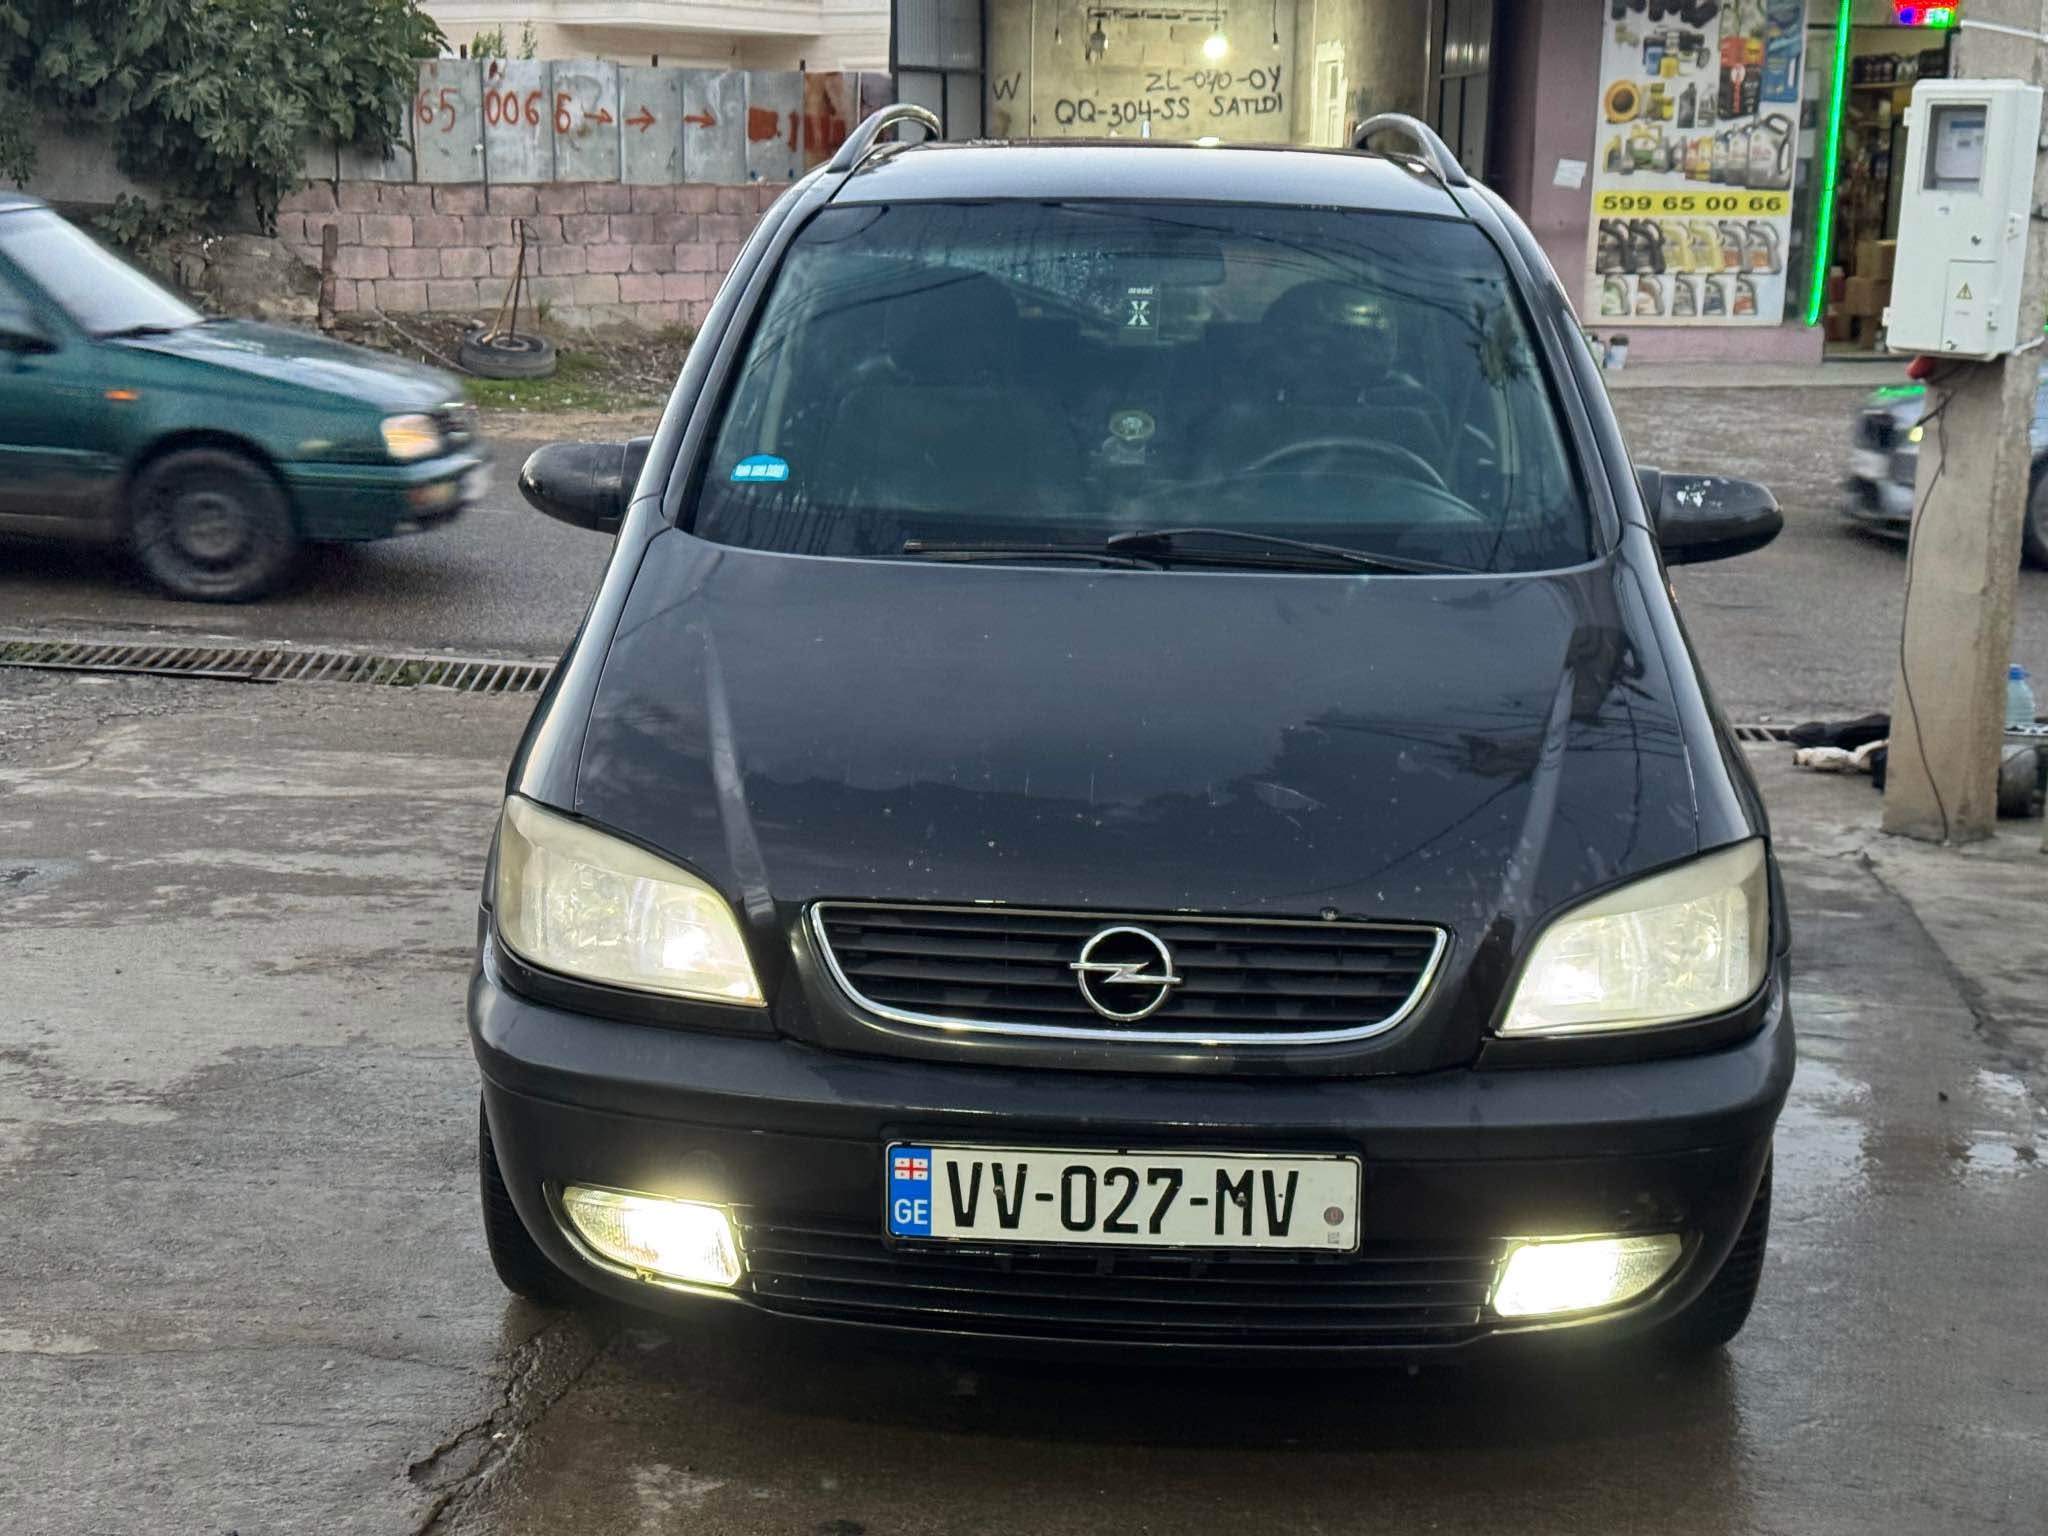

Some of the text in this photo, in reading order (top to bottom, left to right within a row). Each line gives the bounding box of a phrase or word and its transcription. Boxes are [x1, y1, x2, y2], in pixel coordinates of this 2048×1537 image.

[1602, 195, 1781, 212] 599 65 00 66
[946, 1160, 1299, 1237] VV-027-MV
[894, 1199, 928, 1225] GE
